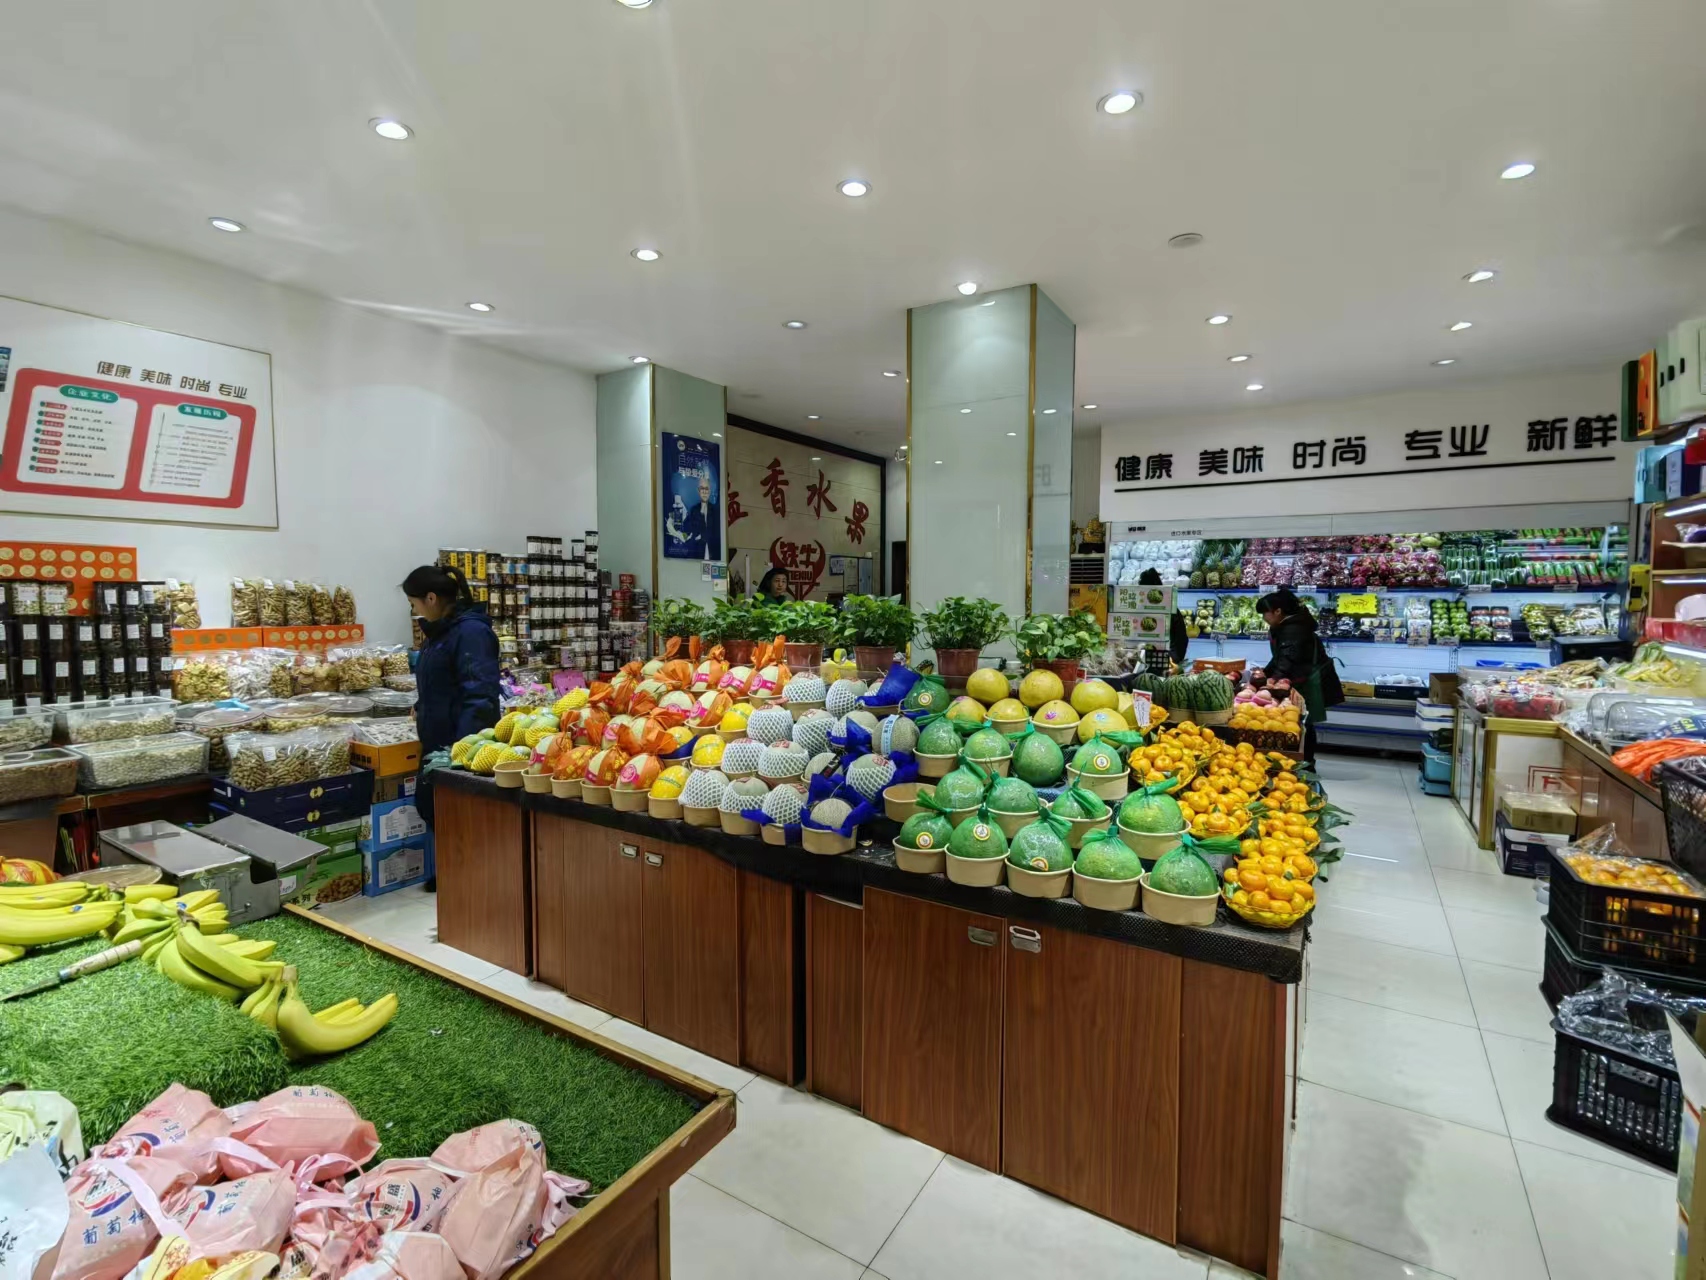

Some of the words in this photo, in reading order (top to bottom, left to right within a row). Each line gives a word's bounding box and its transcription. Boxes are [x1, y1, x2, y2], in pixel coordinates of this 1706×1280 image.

[97, 361, 131, 379] 健康
[140, 368, 172, 385] 美味
[179, 376, 210, 393] 时尚
[218, 383, 248, 399] 专业
[1115, 453, 1173, 482] 健康
[1198, 446, 1264, 476] 美味
[1293, 435, 1367, 468] 时尚
[1404, 424, 1490, 461] 专业
[1527, 414, 1618, 452] 新鲜
